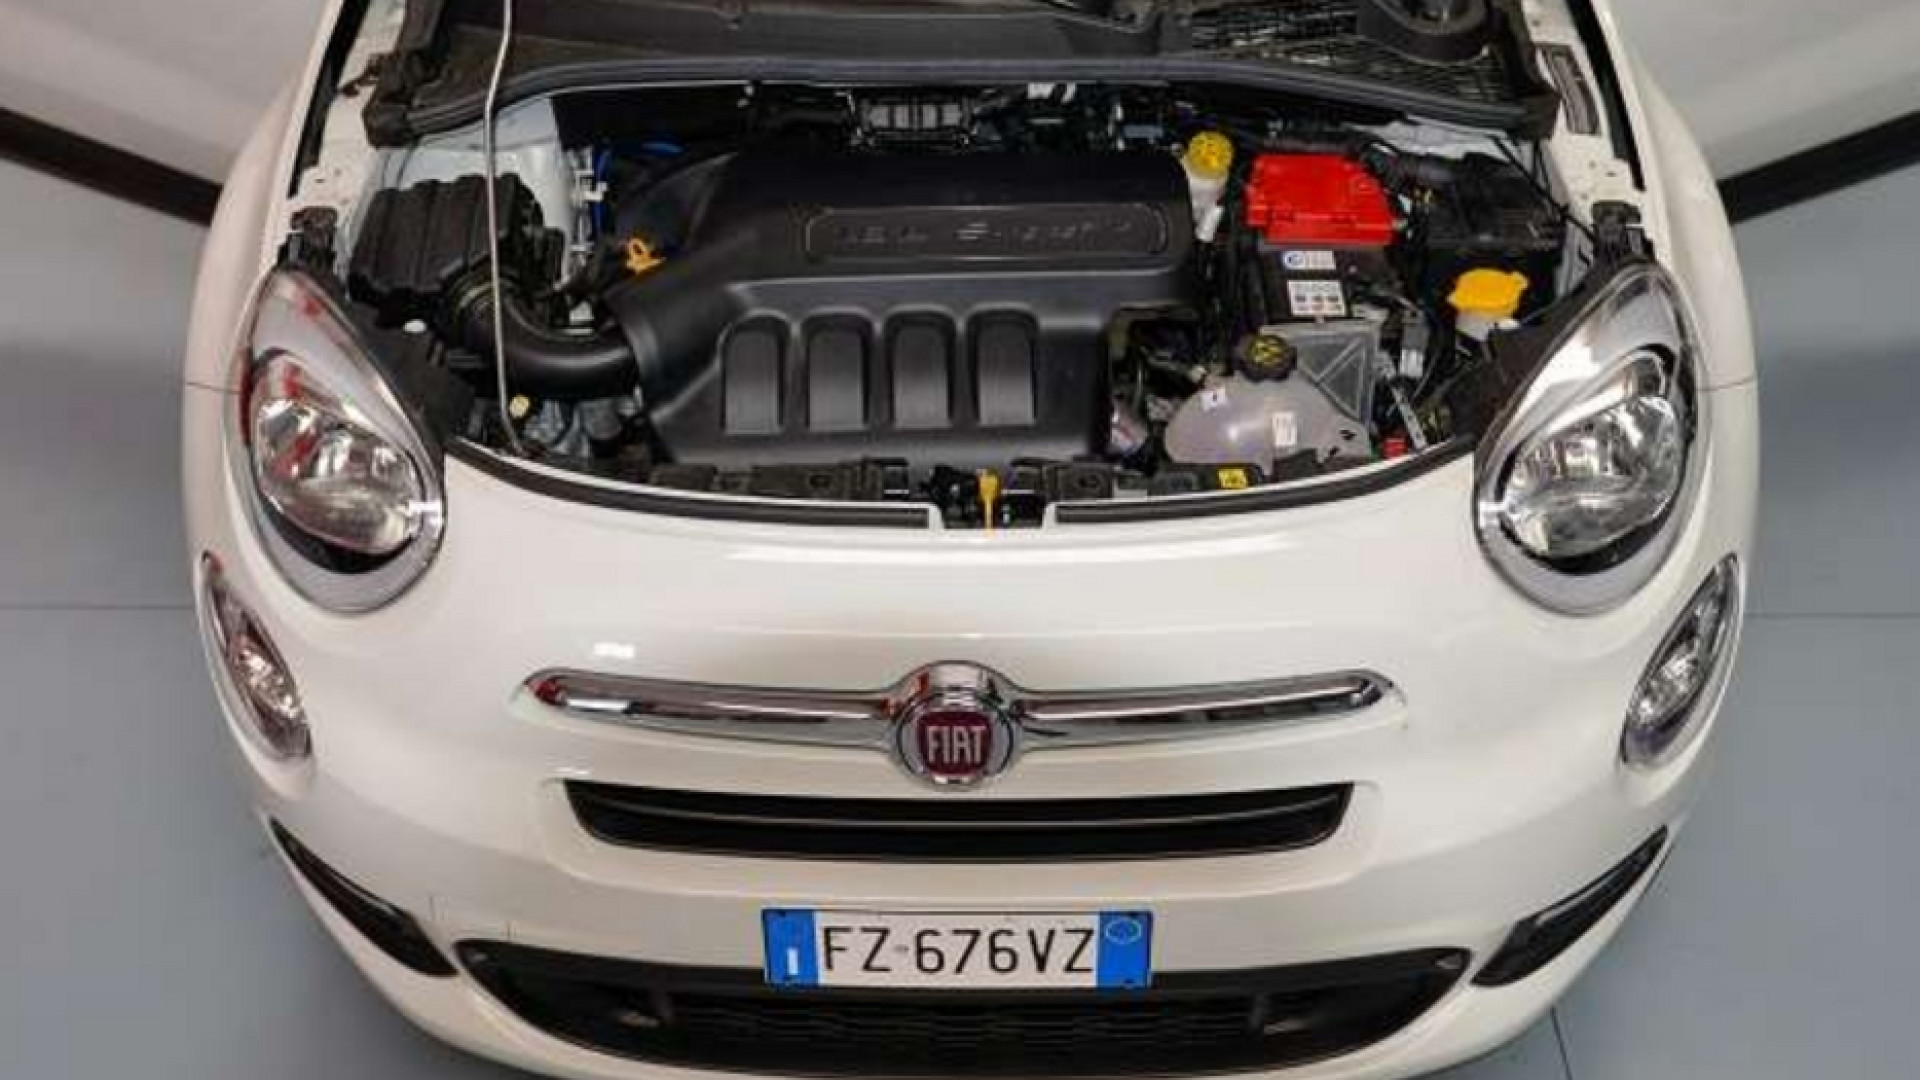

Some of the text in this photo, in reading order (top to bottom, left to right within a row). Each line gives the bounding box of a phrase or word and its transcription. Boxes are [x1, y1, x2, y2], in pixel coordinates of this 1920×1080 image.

[927, 725, 987, 764] FIAT
[822, 926, 1095, 974] FZ 676VZ
